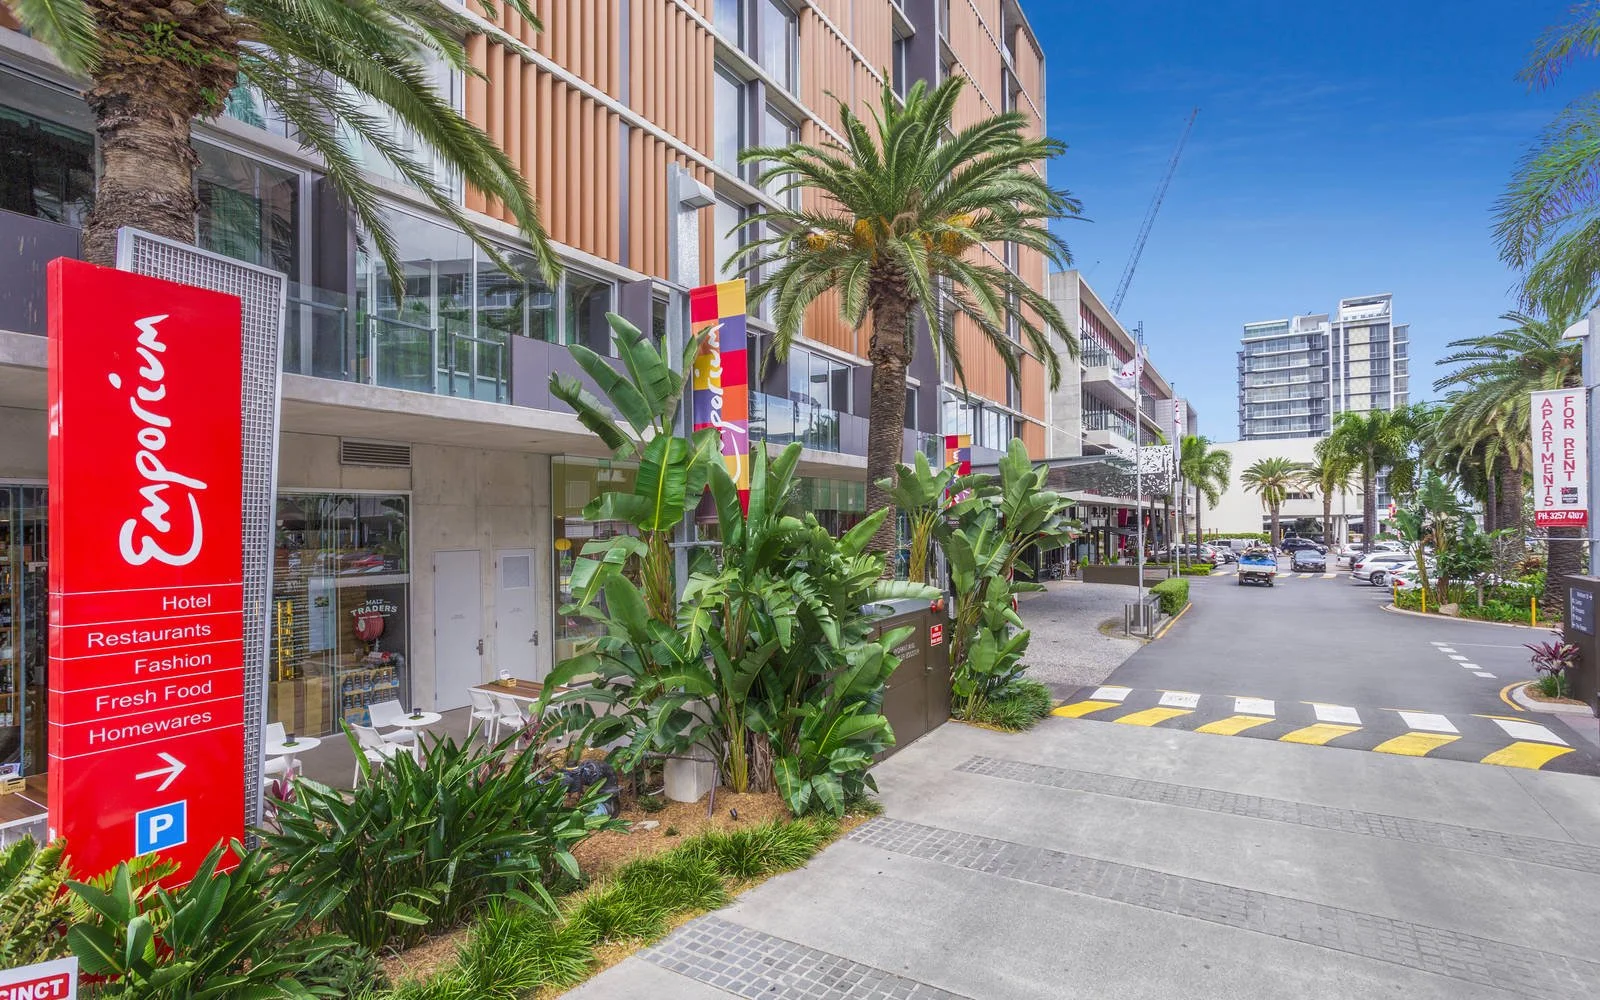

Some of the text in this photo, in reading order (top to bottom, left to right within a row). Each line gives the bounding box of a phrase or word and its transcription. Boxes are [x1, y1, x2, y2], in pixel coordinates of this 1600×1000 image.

[694, 322, 746, 484] porium
[1563, 396, 1575, 429] FOR
[108, 314, 207, 566] Emporium
[1541, 397, 1555, 507] APARTMENTS
[1563, 437, 1576, 482] RENT
[1549, 511, 1567, 519] 3257
[162, 593, 211, 611] Hotel
[350, 605, 398, 616] TRADERS
[87, 623, 212, 648] Restaurants
[134, 653, 212, 675] Fashion
[96, 680, 212, 712] Fresh Food
[89, 711, 212, 745] Homewares
[150, 813, 174, 845] P
